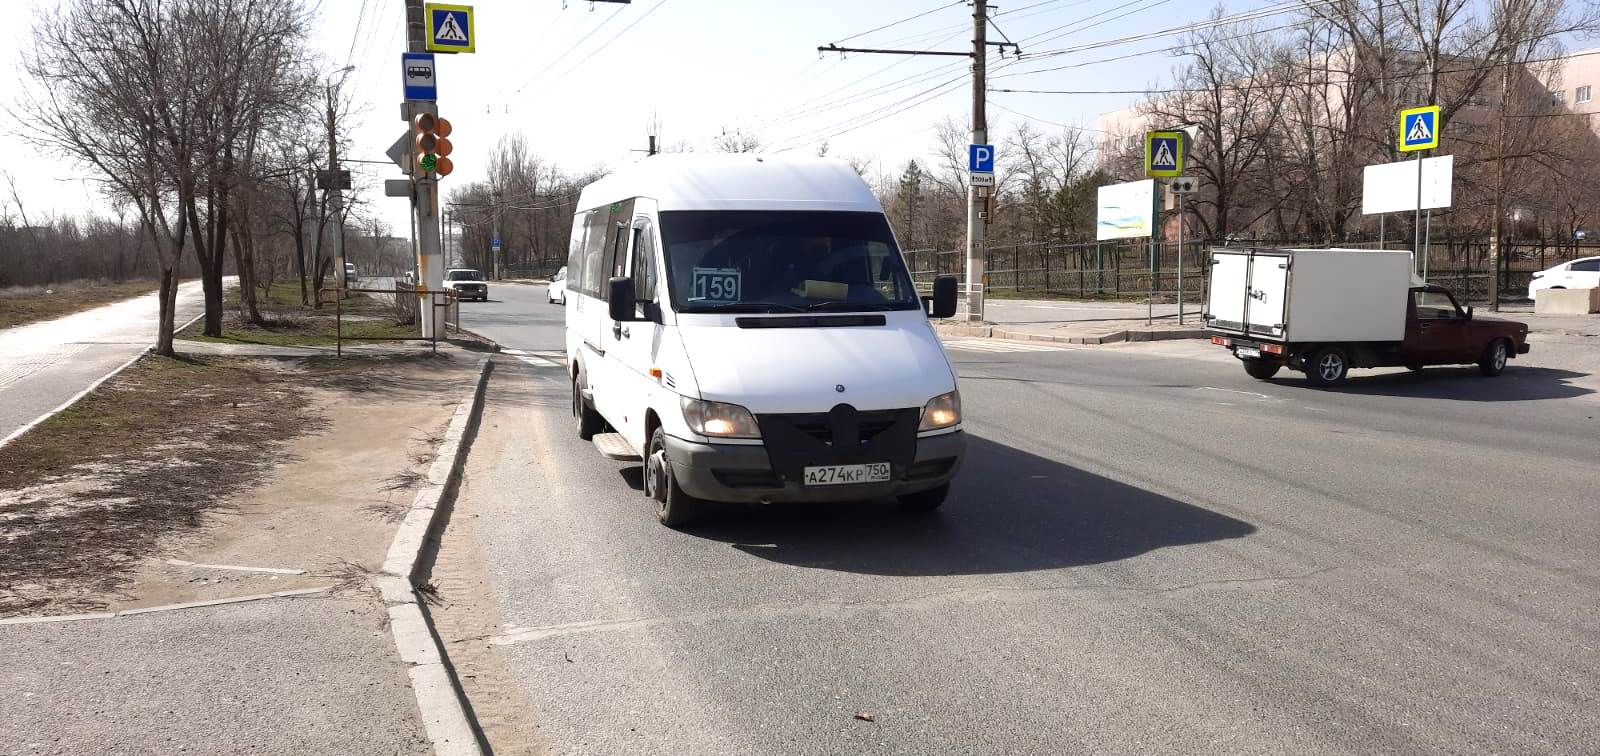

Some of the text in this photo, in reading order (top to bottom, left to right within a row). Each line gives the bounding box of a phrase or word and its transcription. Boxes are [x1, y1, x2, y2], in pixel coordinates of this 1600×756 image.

[976, 147, 990, 168] P
[697, 276, 736, 299] 159
[866, 464, 886, 476] 750
